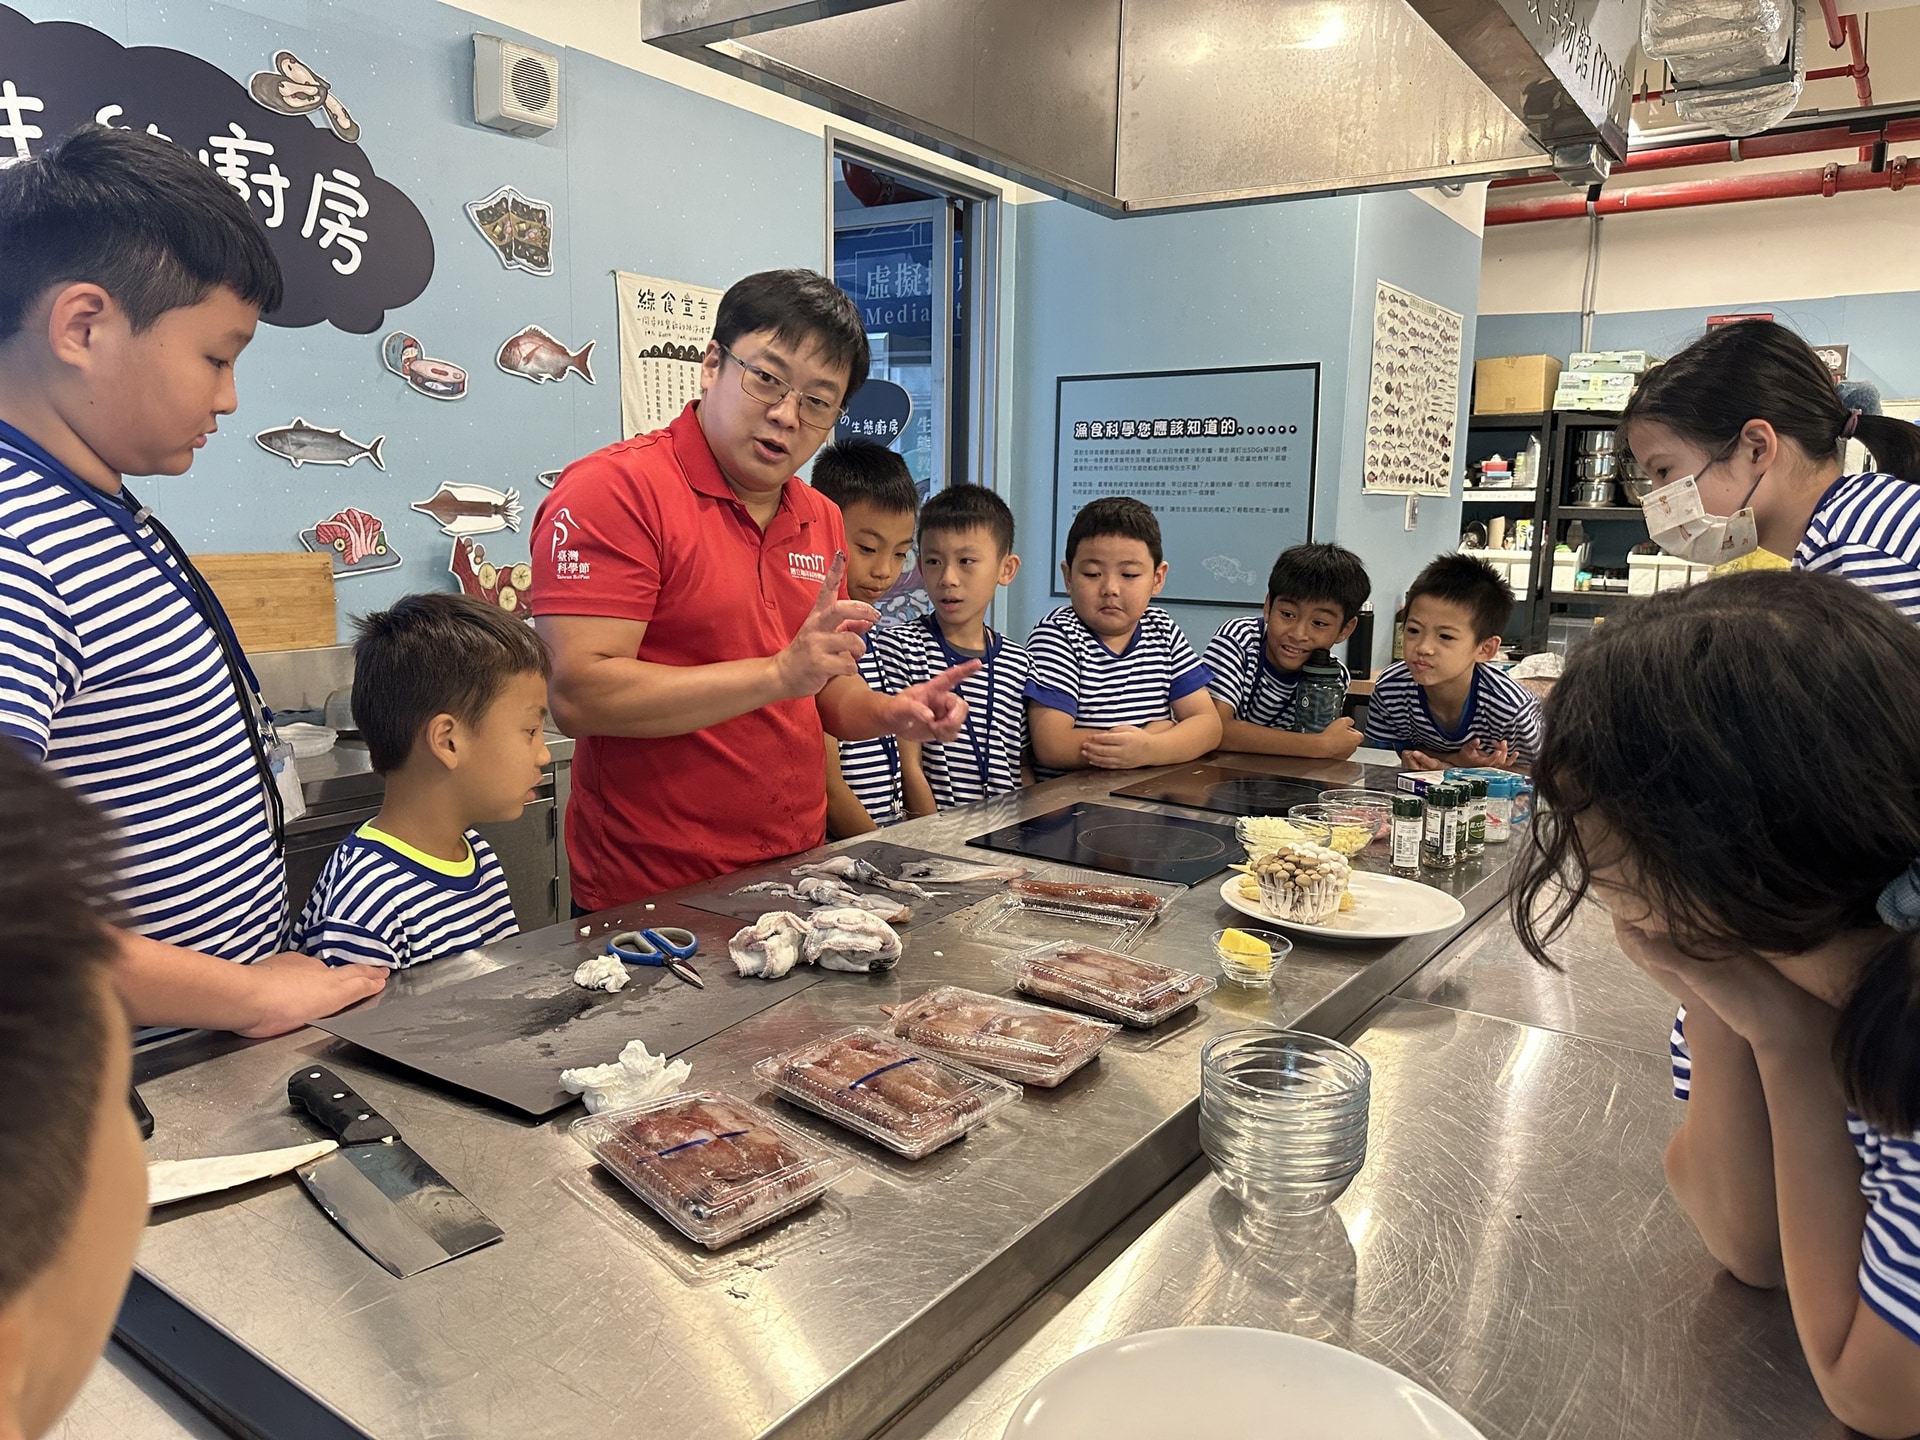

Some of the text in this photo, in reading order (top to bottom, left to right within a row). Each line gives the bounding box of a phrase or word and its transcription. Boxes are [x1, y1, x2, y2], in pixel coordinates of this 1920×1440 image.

[866, 303, 930, 326] Media
[667, 347, 673, 357] 4
[679, 349, 684, 359] 3
[689, 350, 696, 360] 2
[557, 549, 579, 562] 臺灣
[557, 562, 590, 575] 科學節
